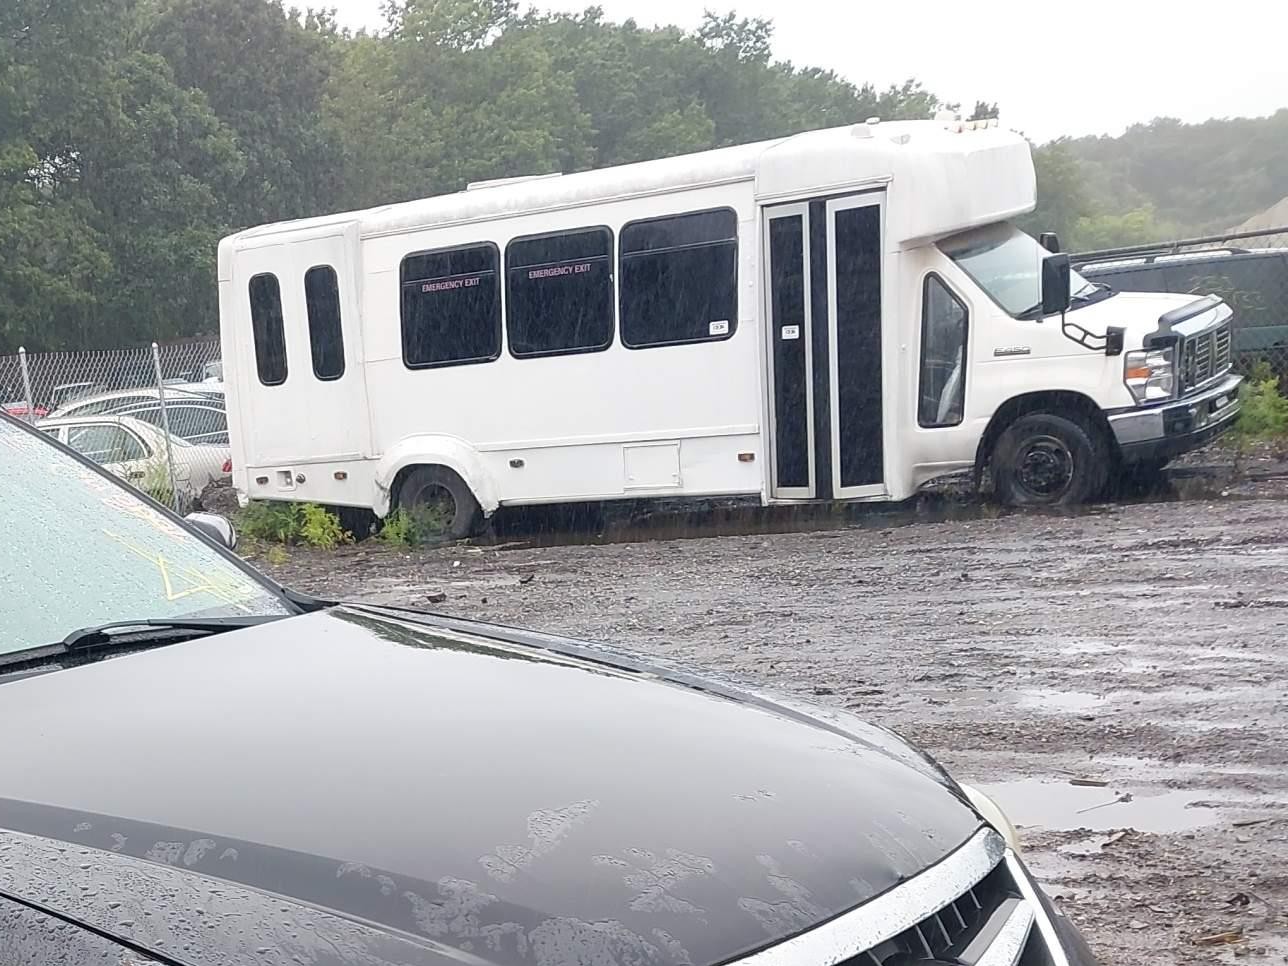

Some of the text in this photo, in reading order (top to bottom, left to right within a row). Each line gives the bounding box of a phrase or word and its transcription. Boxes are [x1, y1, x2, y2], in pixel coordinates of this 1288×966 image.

[528, 263, 592, 280] EMERGENCY EXIT
[421, 277, 481, 293] EMERGENCY EXIT
